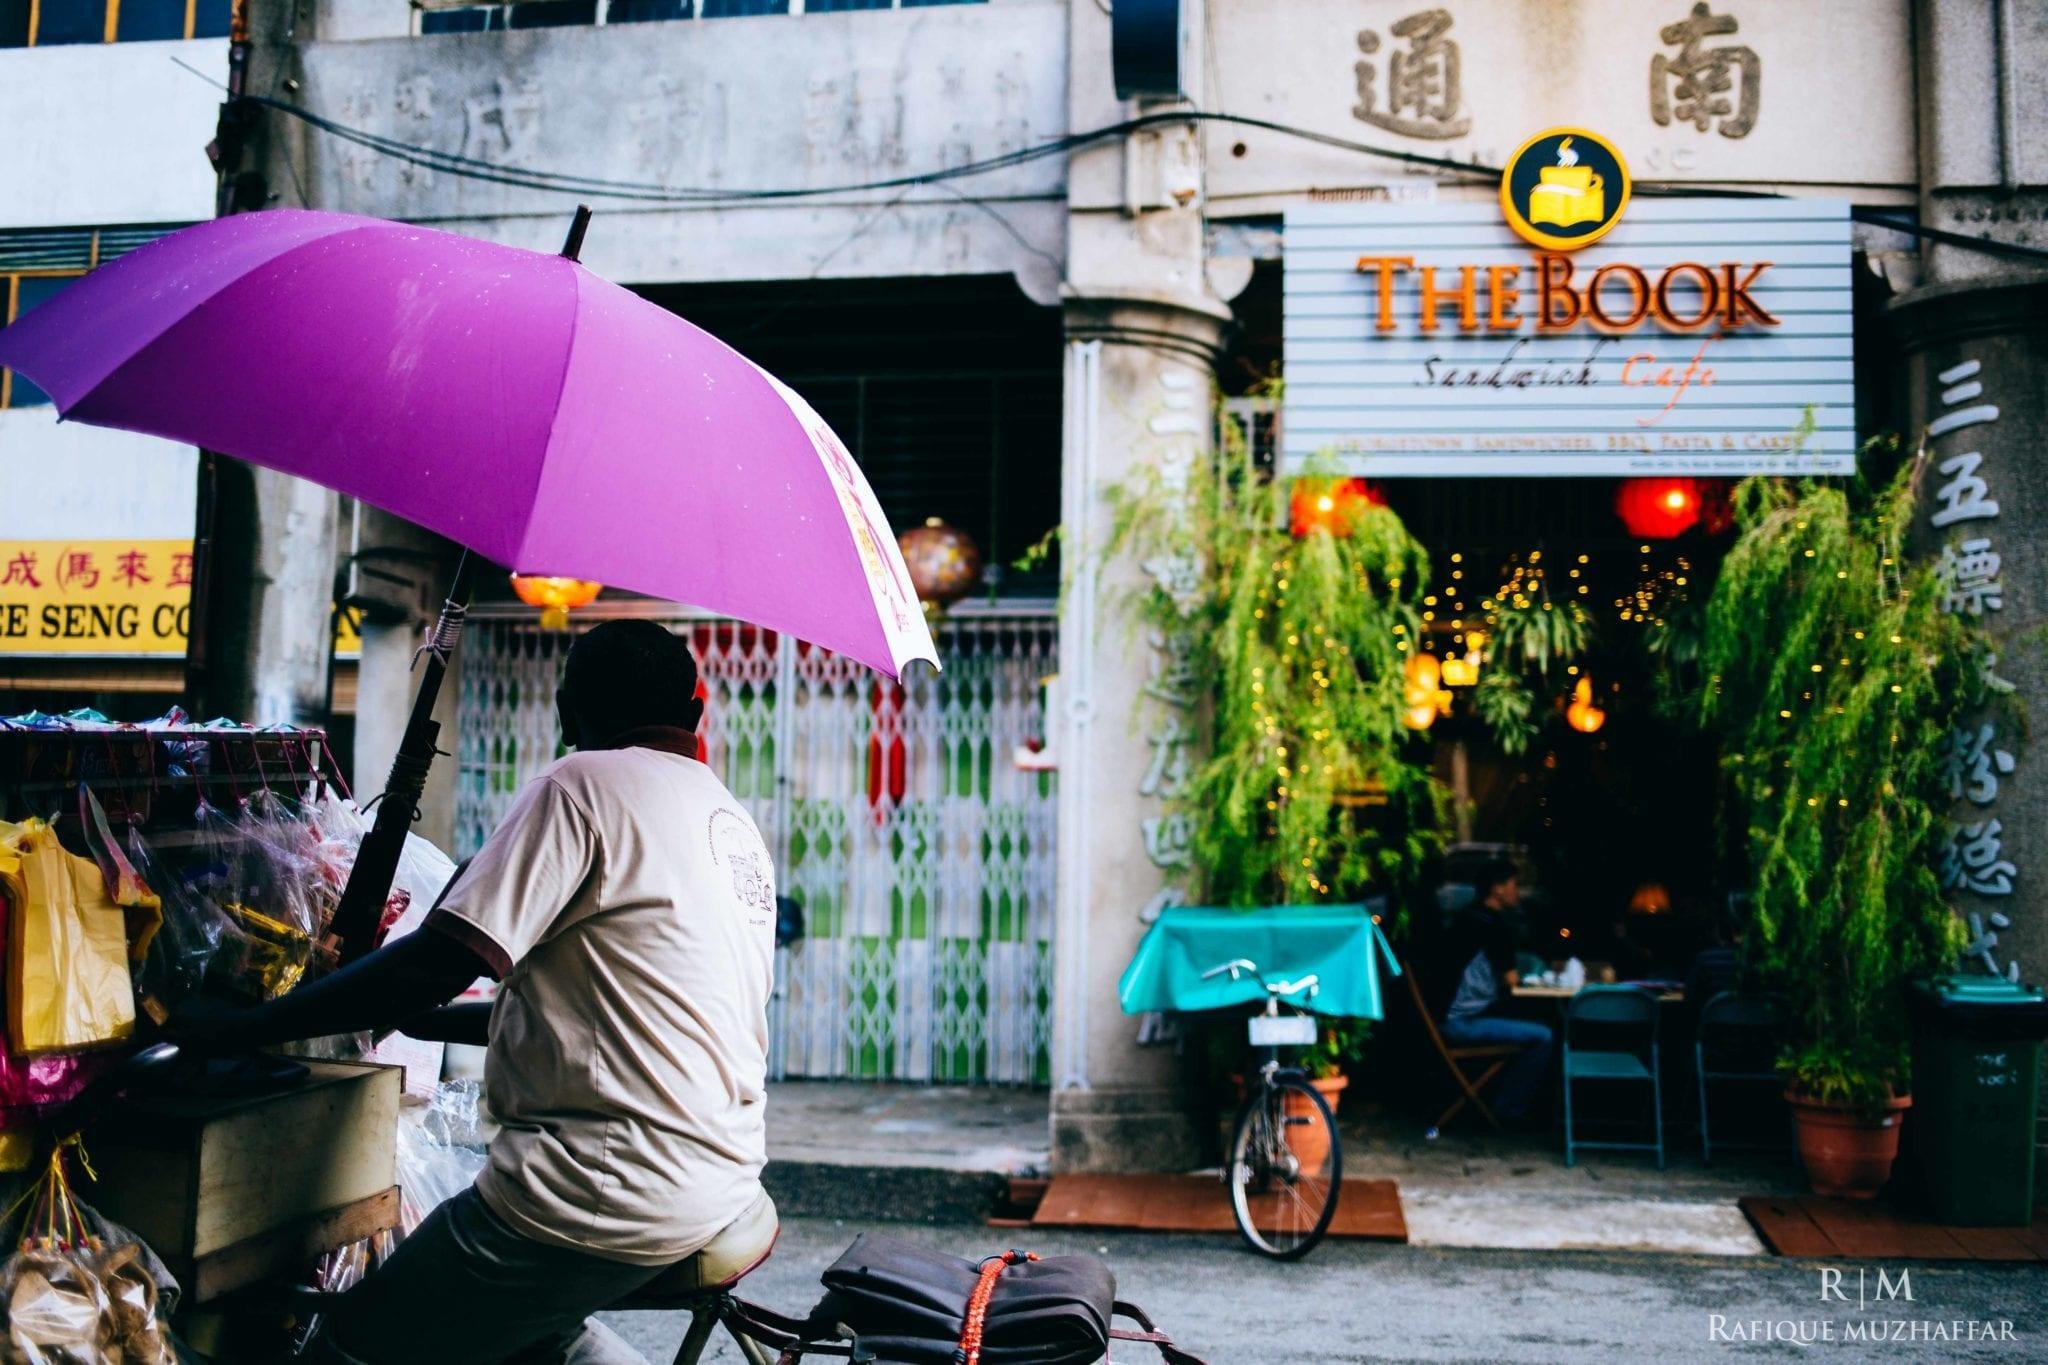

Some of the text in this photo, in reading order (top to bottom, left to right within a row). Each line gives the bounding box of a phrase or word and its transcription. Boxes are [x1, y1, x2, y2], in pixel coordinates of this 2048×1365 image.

[1356, 252, 1782, 335] THE BOOK
[1413, 337, 1619, 390] Sandwich
[0, 604, 29, 638] E
[40, 604, 140, 638] SENG
